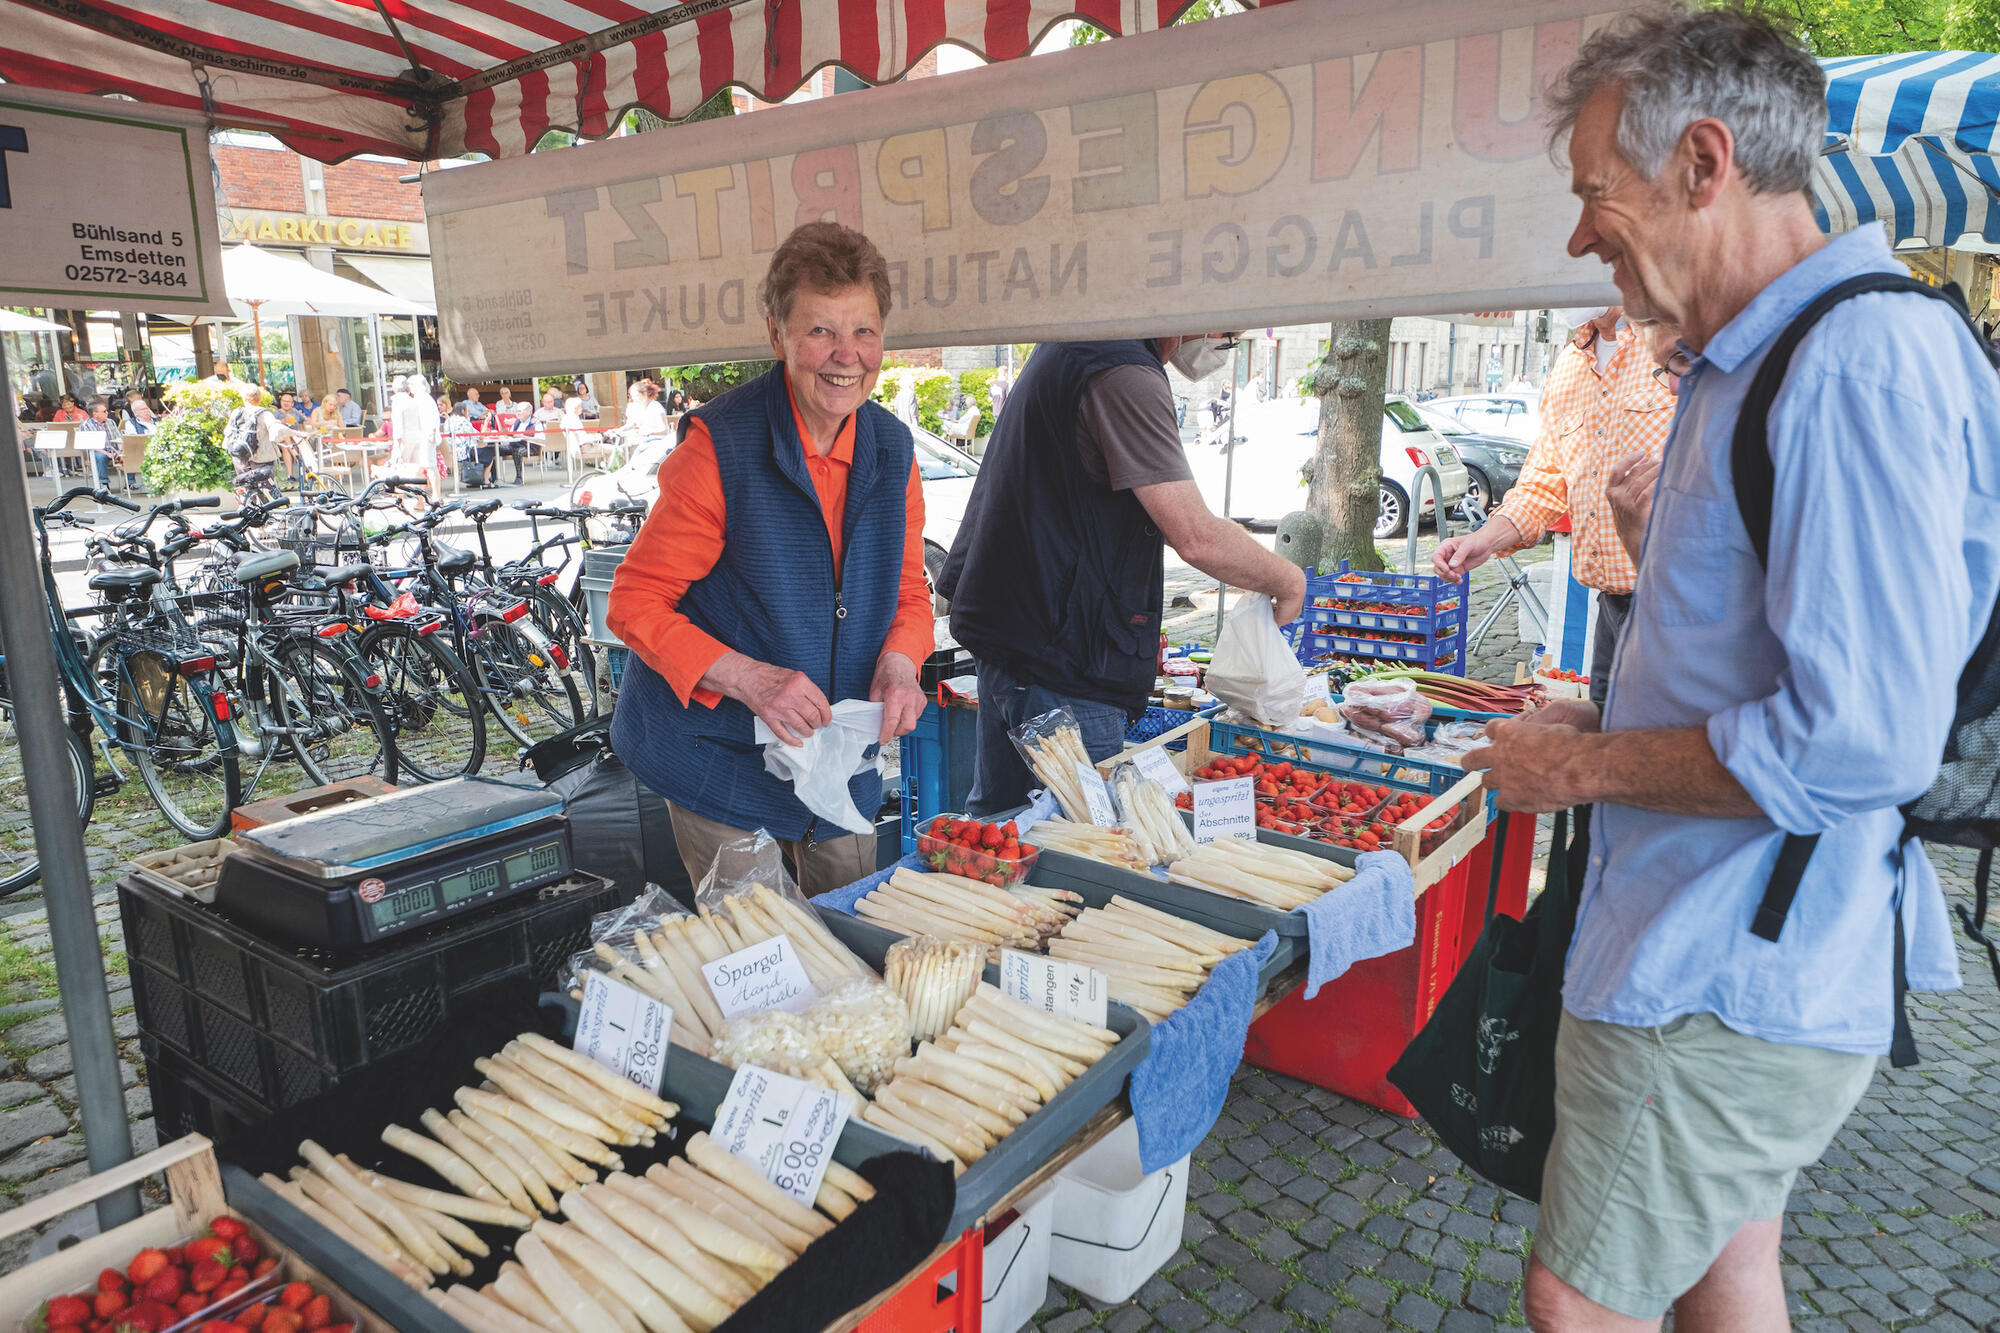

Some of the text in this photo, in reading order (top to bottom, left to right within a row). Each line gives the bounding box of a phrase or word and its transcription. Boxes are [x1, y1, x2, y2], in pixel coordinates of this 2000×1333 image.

[608, 0, 734, 42] www.plana-schirme.d
[481, 43, 587, 84] www.plana-schirme.de
[72, 222, 184, 247] Bühlsand 5
[65, 264, 188, 287] 02572-3484
[80, 245, 186, 267] Emsdetten
[1200, 815, 1250, 828] Abschnitte
[714, 944, 783, 987] Spargel
[627, 1040, 648, 1085] 6.00
[642, 1043, 660, 1090] 12.00
[776, 1140, 808, 1191] 6.00
[793, 1142, 824, 1197] 12.00
